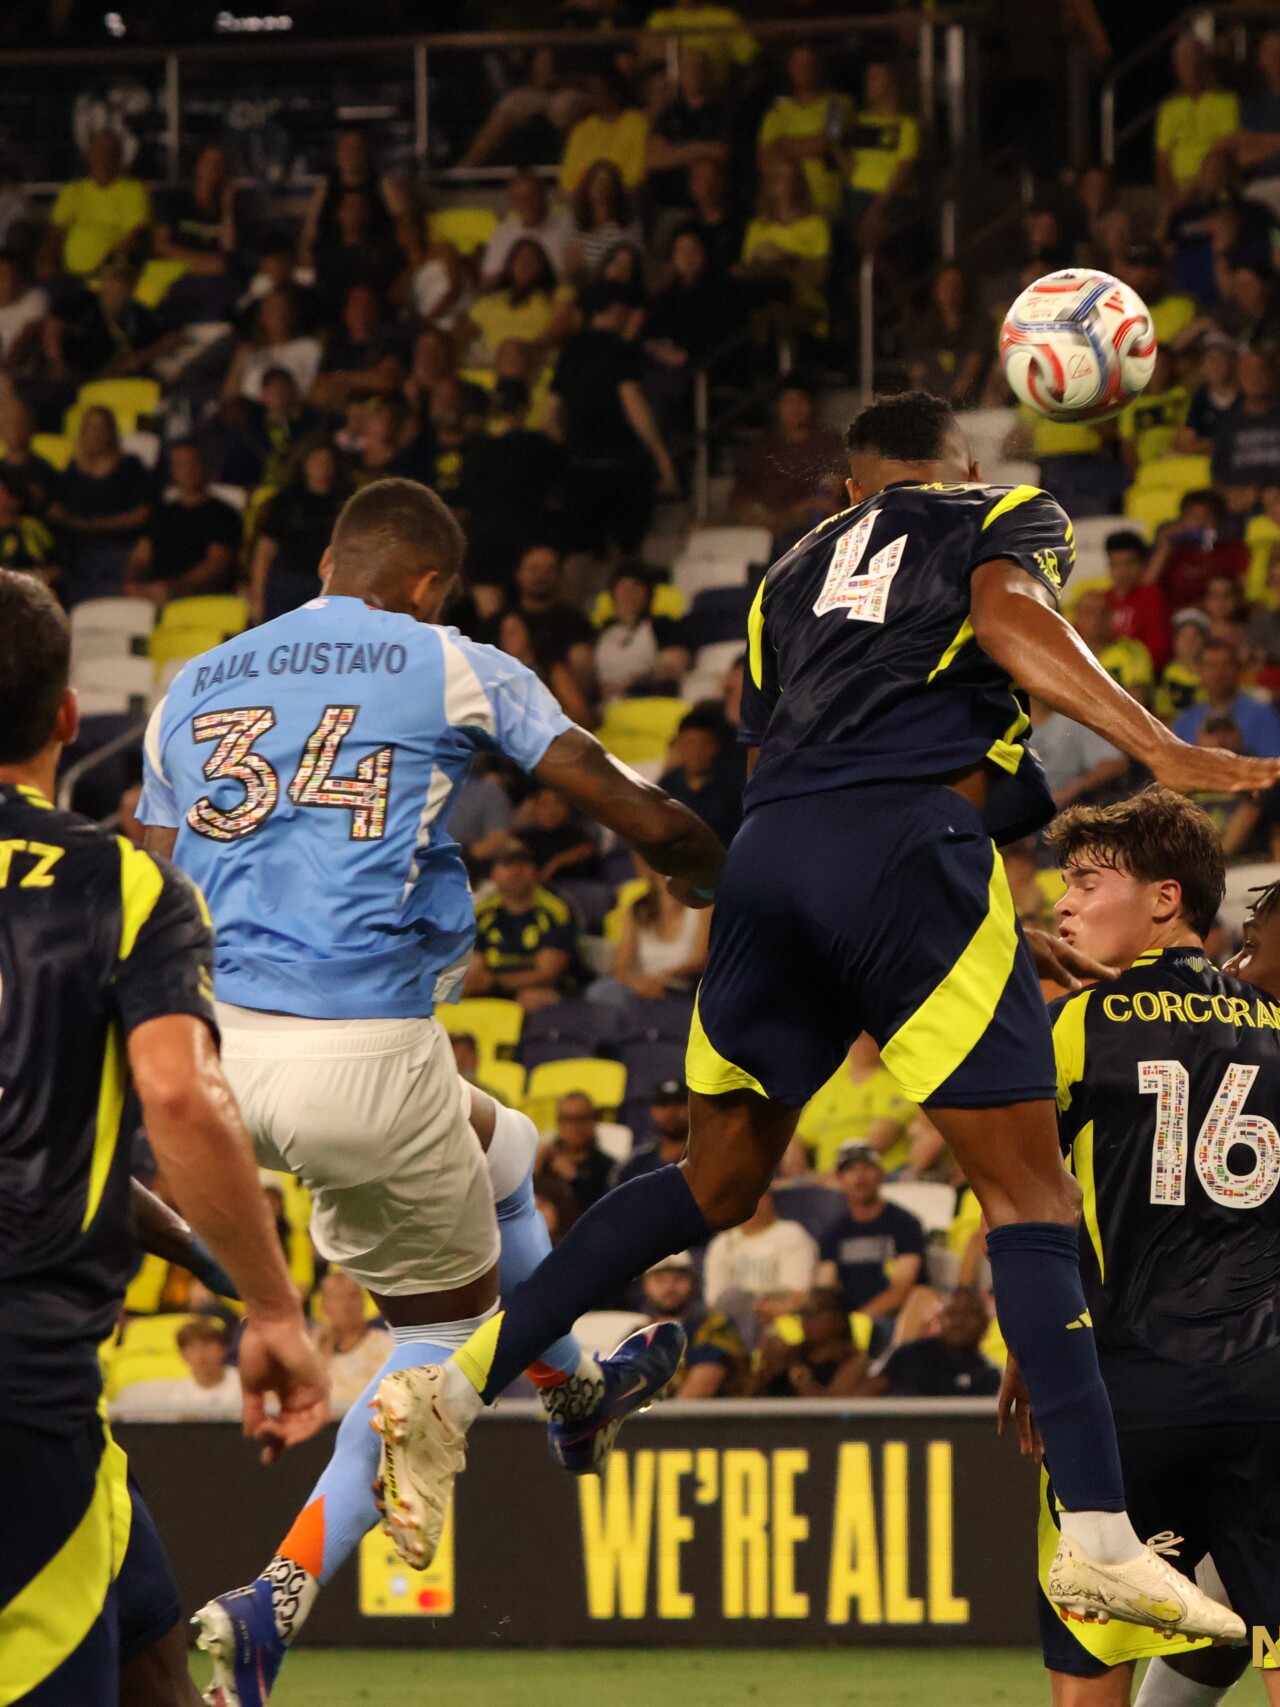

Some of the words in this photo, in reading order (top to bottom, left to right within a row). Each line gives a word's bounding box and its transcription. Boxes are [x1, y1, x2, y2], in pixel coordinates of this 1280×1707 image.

[812, 509, 908, 624] 4
[192, 650, 260, 698] RAUL
[268, 641, 408, 676] GUSTAVO
[186, 704, 396, 844] 34
[826, 1441, 970, 1625] ALL
